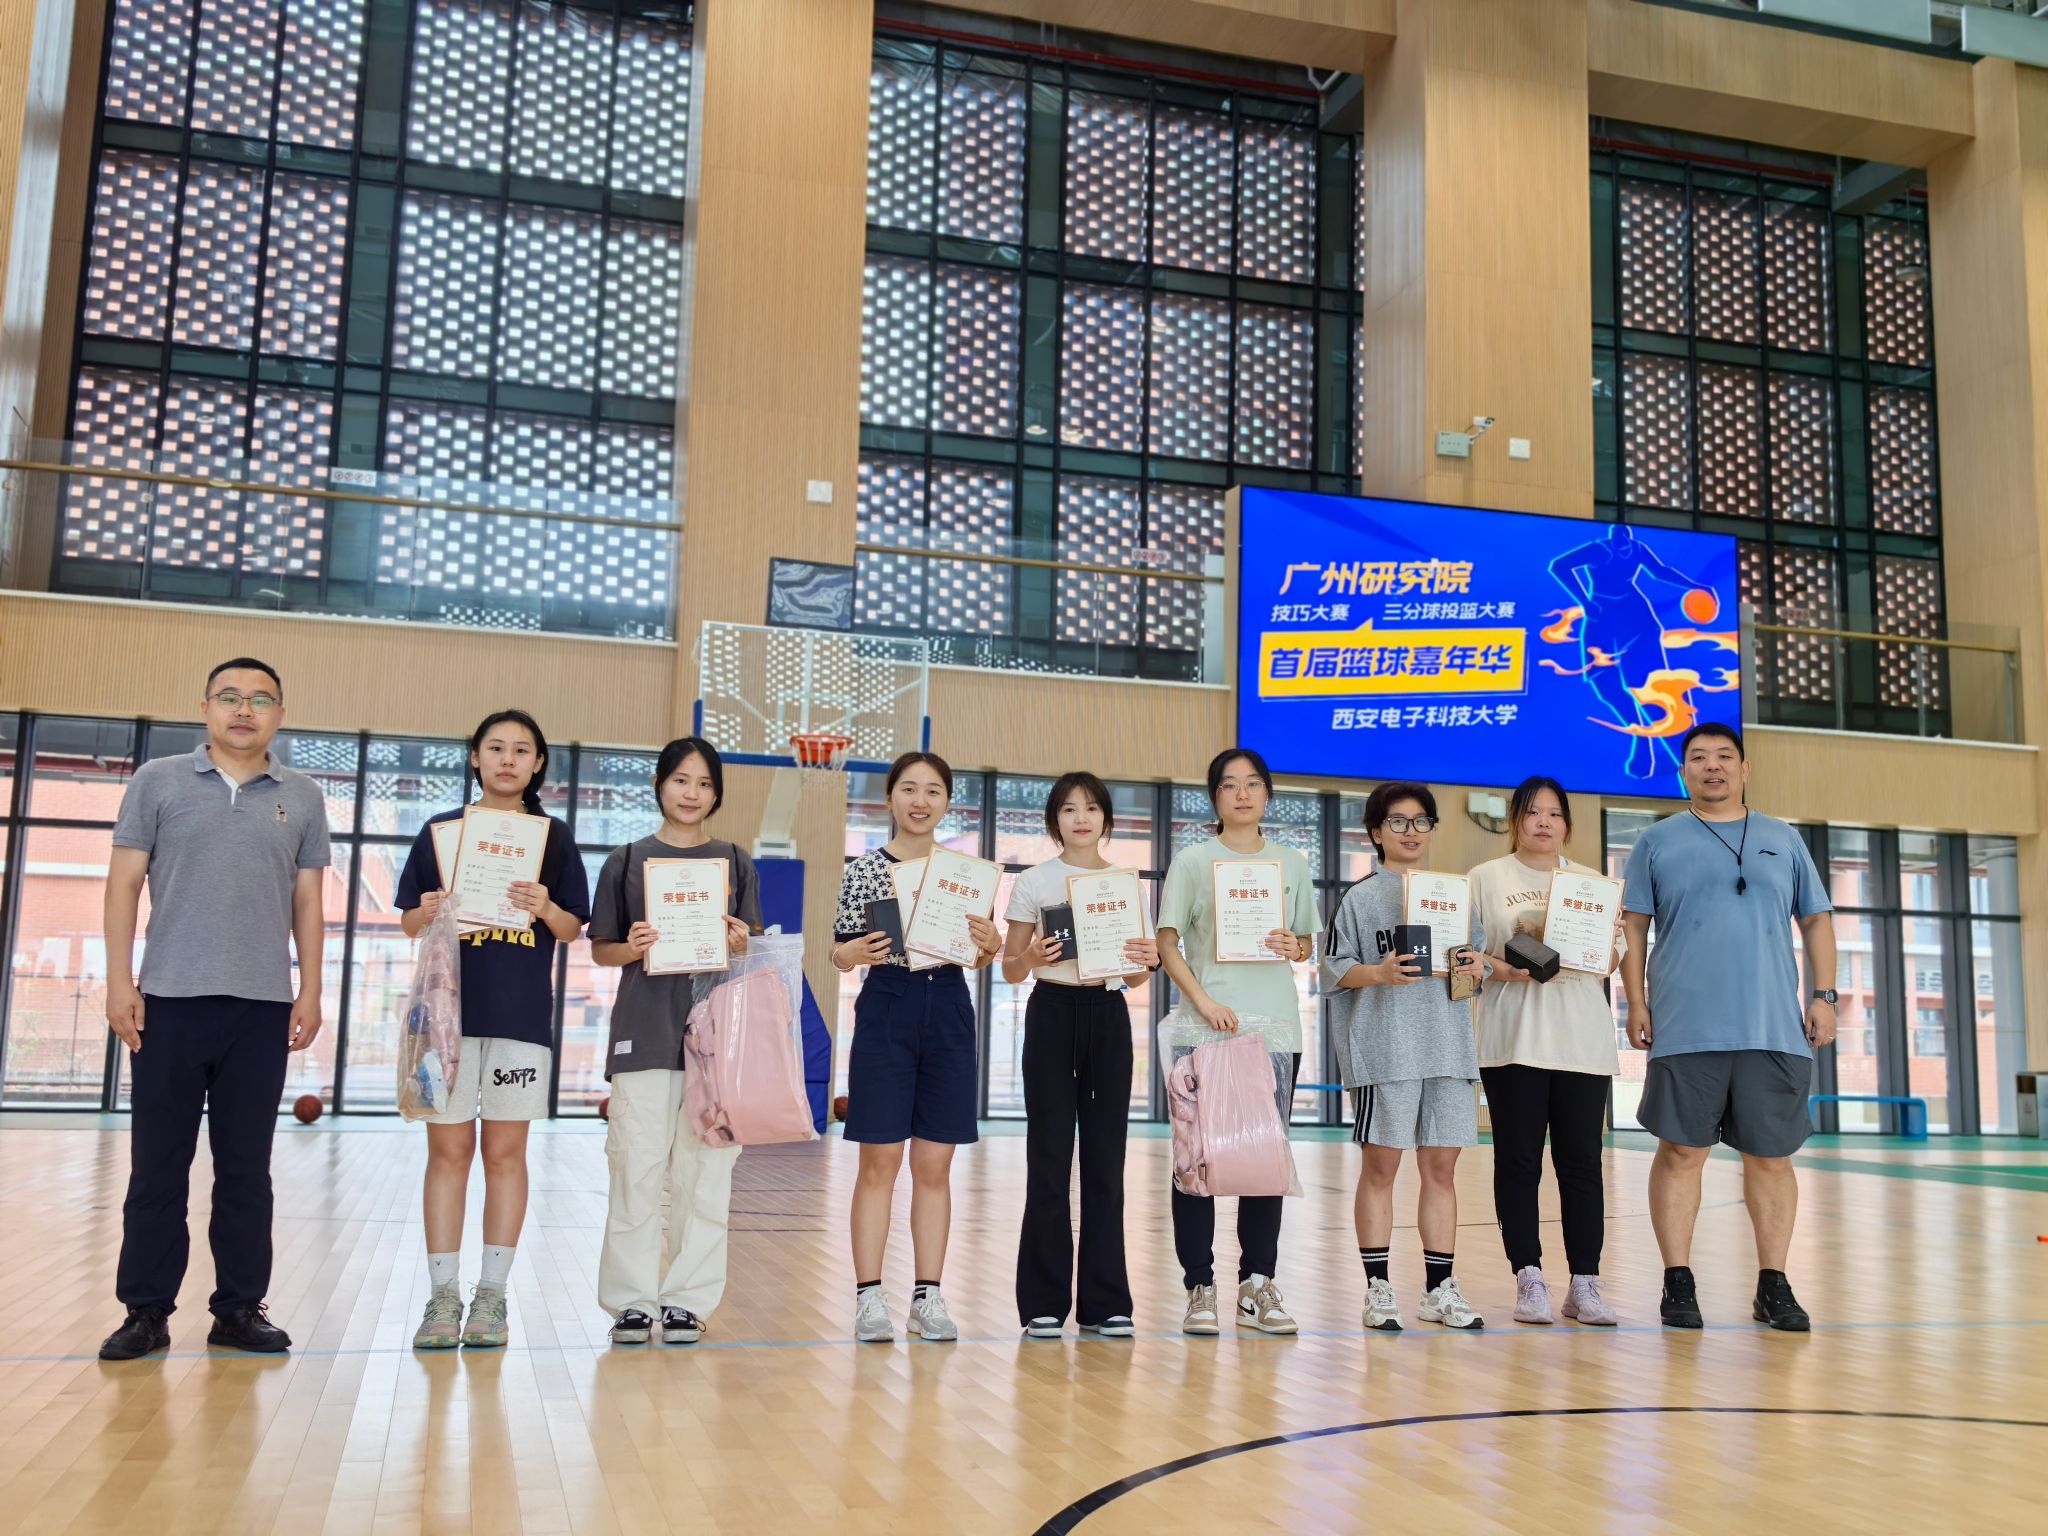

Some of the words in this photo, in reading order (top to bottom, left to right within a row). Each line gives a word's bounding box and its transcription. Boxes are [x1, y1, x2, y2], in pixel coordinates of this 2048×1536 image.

[1279, 559, 1474, 596] 广州研究院
[1270, 603, 1351, 623] 技巧大赛
[1382, 601, 1517, 621] 三分球投篮大赛
[1270, 644, 1514, 680] 首届篮球嘉年华
[1332, 704, 1519, 730] 西安电子科技大学
[477, 840, 526, 858] 荣誉证书
[663, 891, 710, 904] 荣誉证书
[937, 878, 981, 899] 荣誉证书
[1228, 888, 1270, 900] 荣誉证书
[1086, 900, 1127, 914] 荣誉证书
[1420, 899, 1458, 912] 荣誉证书
[1562, 897, 1604, 913] 荣誉证书
